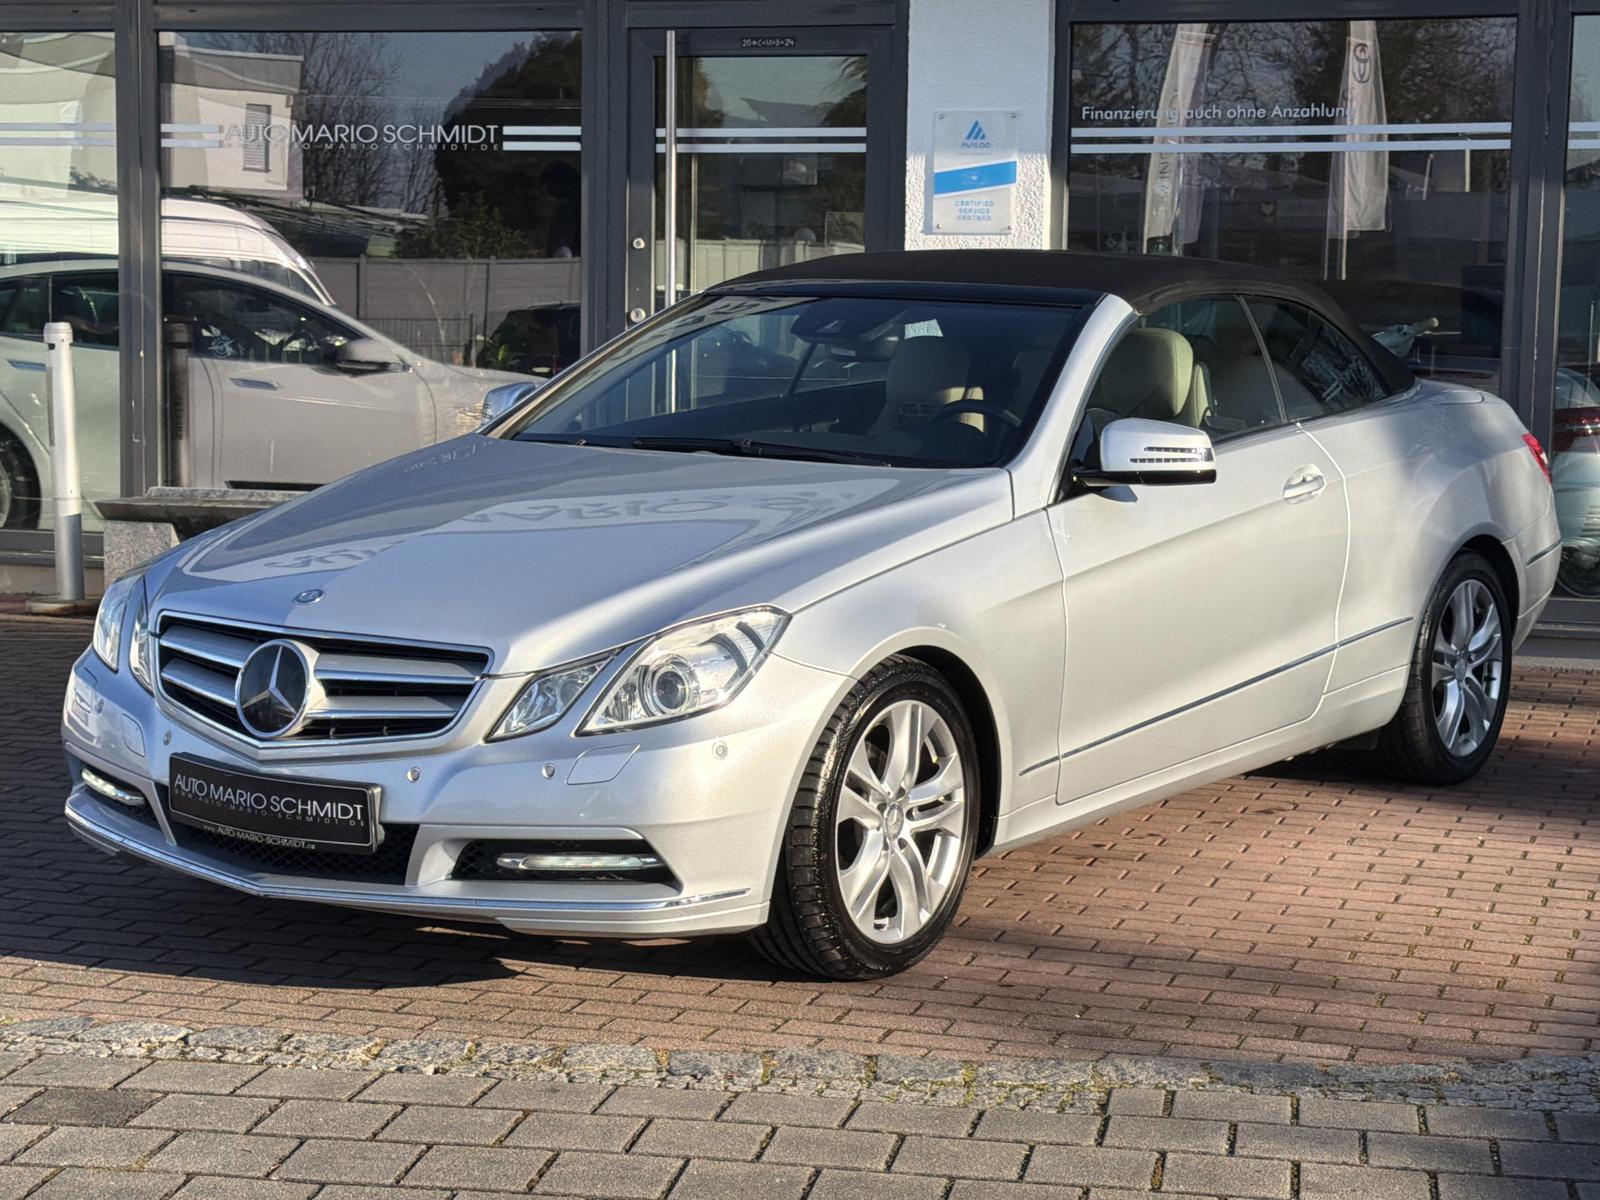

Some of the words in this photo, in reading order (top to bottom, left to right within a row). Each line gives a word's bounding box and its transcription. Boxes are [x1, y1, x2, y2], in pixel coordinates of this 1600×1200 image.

[1186, 104, 1222, 120] auch
[1227, 104, 1266, 119] ohne
[224, 124, 289, 141] AUTO
[291, 124, 377, 142] MARIO
[383, 124, 498, 143] SCHMIDT
[174, 773, 207, 796] AUTO
[210, 783, 267, 809] MARIO
[270, 796, 364, 820] SCHMIDT
